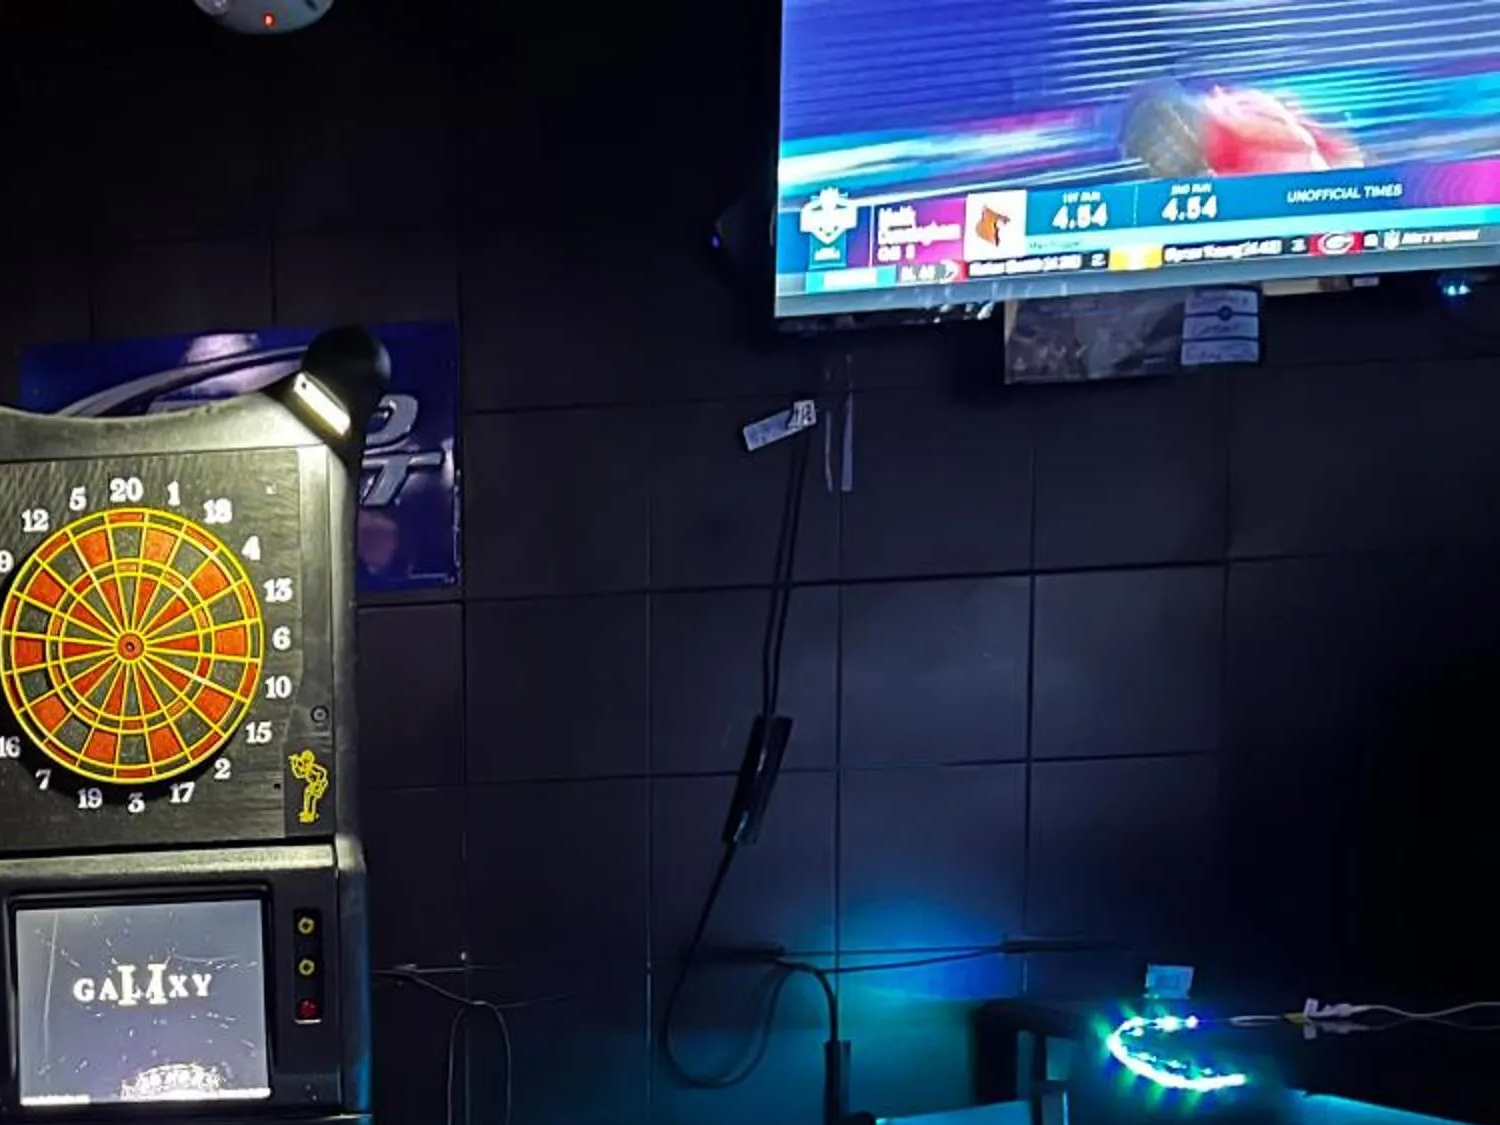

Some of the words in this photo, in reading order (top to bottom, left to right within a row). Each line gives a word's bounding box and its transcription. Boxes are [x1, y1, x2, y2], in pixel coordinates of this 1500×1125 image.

[1287, 187, 1360, 203] UNOFFICIAL
[1364, 183, 1403, 198] TIMES
[1052, 202, 1109, 229] 4.54
[1162, 196, 1217, 221] 4.54
[69, 485, 87, 512] 5
[109, 476, 145, 503] 20
[168, 482, 181, 505] 1
[21, 508, 50, 533] 12
[204, 498, 233, 525] 18
[242, 536, 262, 561] 4
[264, 578, 293, 602] 13
[271, 625, 292, 651] 6
[264, 675, 293, 699] 10
[245, 720, 273, 744] 15
[35, 770, 50, 790] 7
[214, 757, 231, 780] 2
[78, 788, 103, 810] 19
[127, 791, 146, 814] 3
[169, 781, 196, 804] 17
